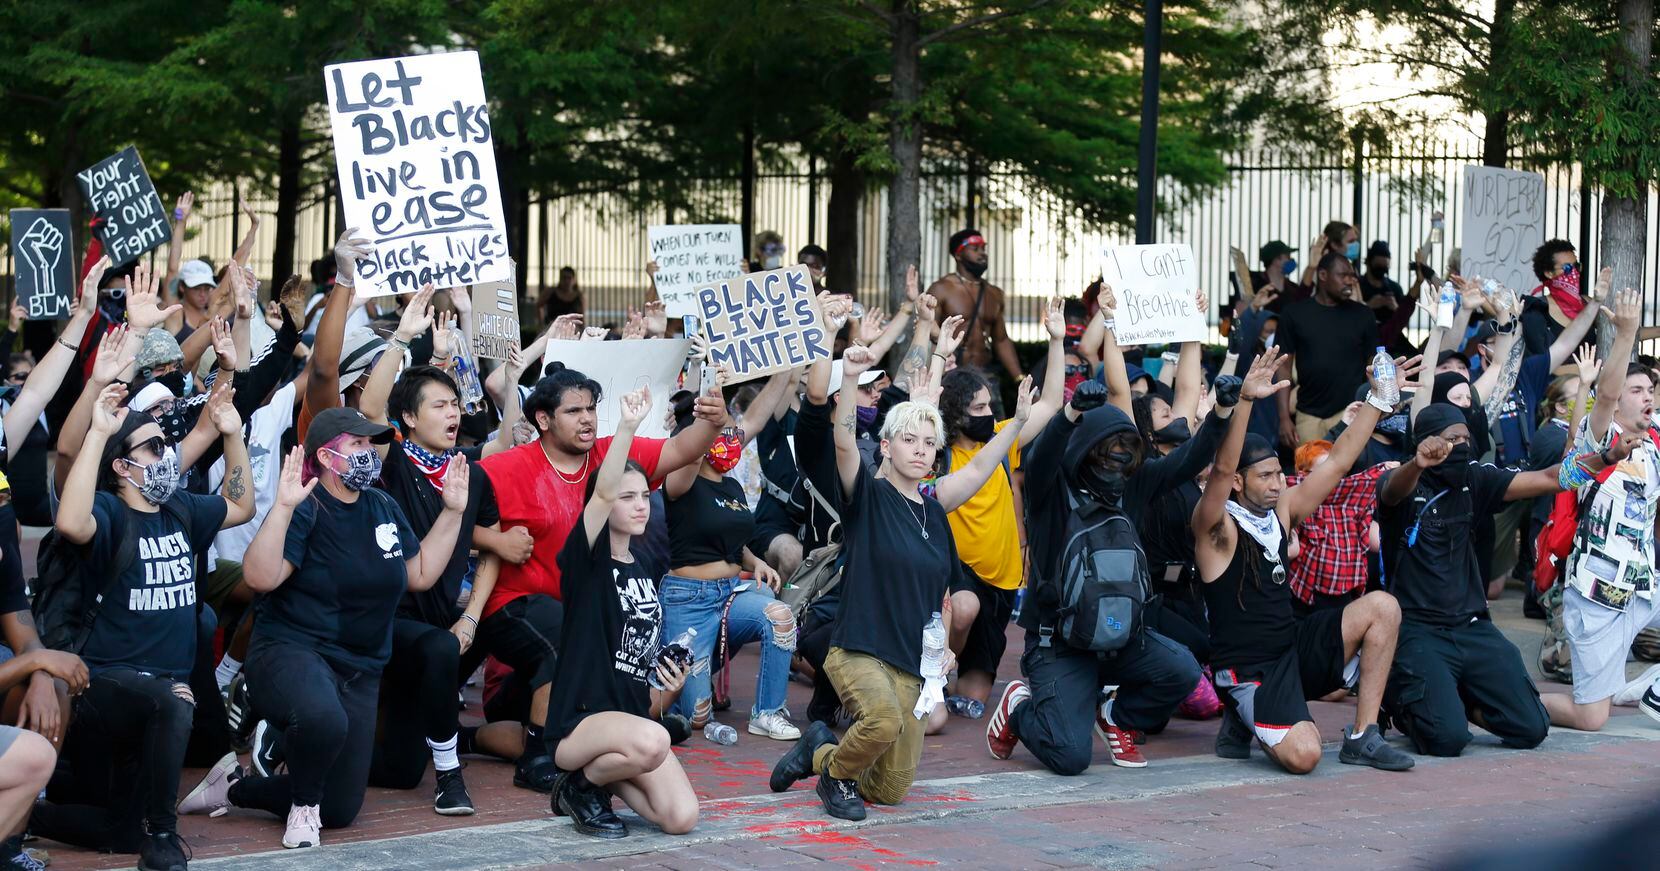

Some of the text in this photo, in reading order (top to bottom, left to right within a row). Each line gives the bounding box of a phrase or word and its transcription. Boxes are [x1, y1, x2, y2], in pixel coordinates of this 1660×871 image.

[332, 60, 423, 113] Let
[352, 100, 490, 155] Blacks
[77, 158, 124, 197] Your
[352, 146, 481, 200] live in
[91, 172, 140, 213] Fight
[371, 184, 490, 235] ease
[104, 216, 118, 239] is
[111, 217, 165, 262] Fight
[651, 231, 732, 254] WHEN OUR TURN
[355, 234, 507, 279] Black lives
[656, 252, 737, 267] COMES WE WILL
[1141, 248, 1186, 279] Can't
[378, 259, 494, 293] matter
[655, 272, 681, 287] MAKE
[688, 271, 702, 283] NO
[29, 295, 72, 317] BLM
[662, 292, 681, 303] FOR
[698, 271, 808, 320] BLACK
[478, 312, 502, 337] WHITE
[704, 299, 816, 344] LIVES
[710, 328, 831, 374] MATTER
[138, 531, 190, 560] BLACK
[144, 556, 192, 585] LIVES
[615, 650, 629, 661] CAT
[615, 661, 636, 674] WHITE
